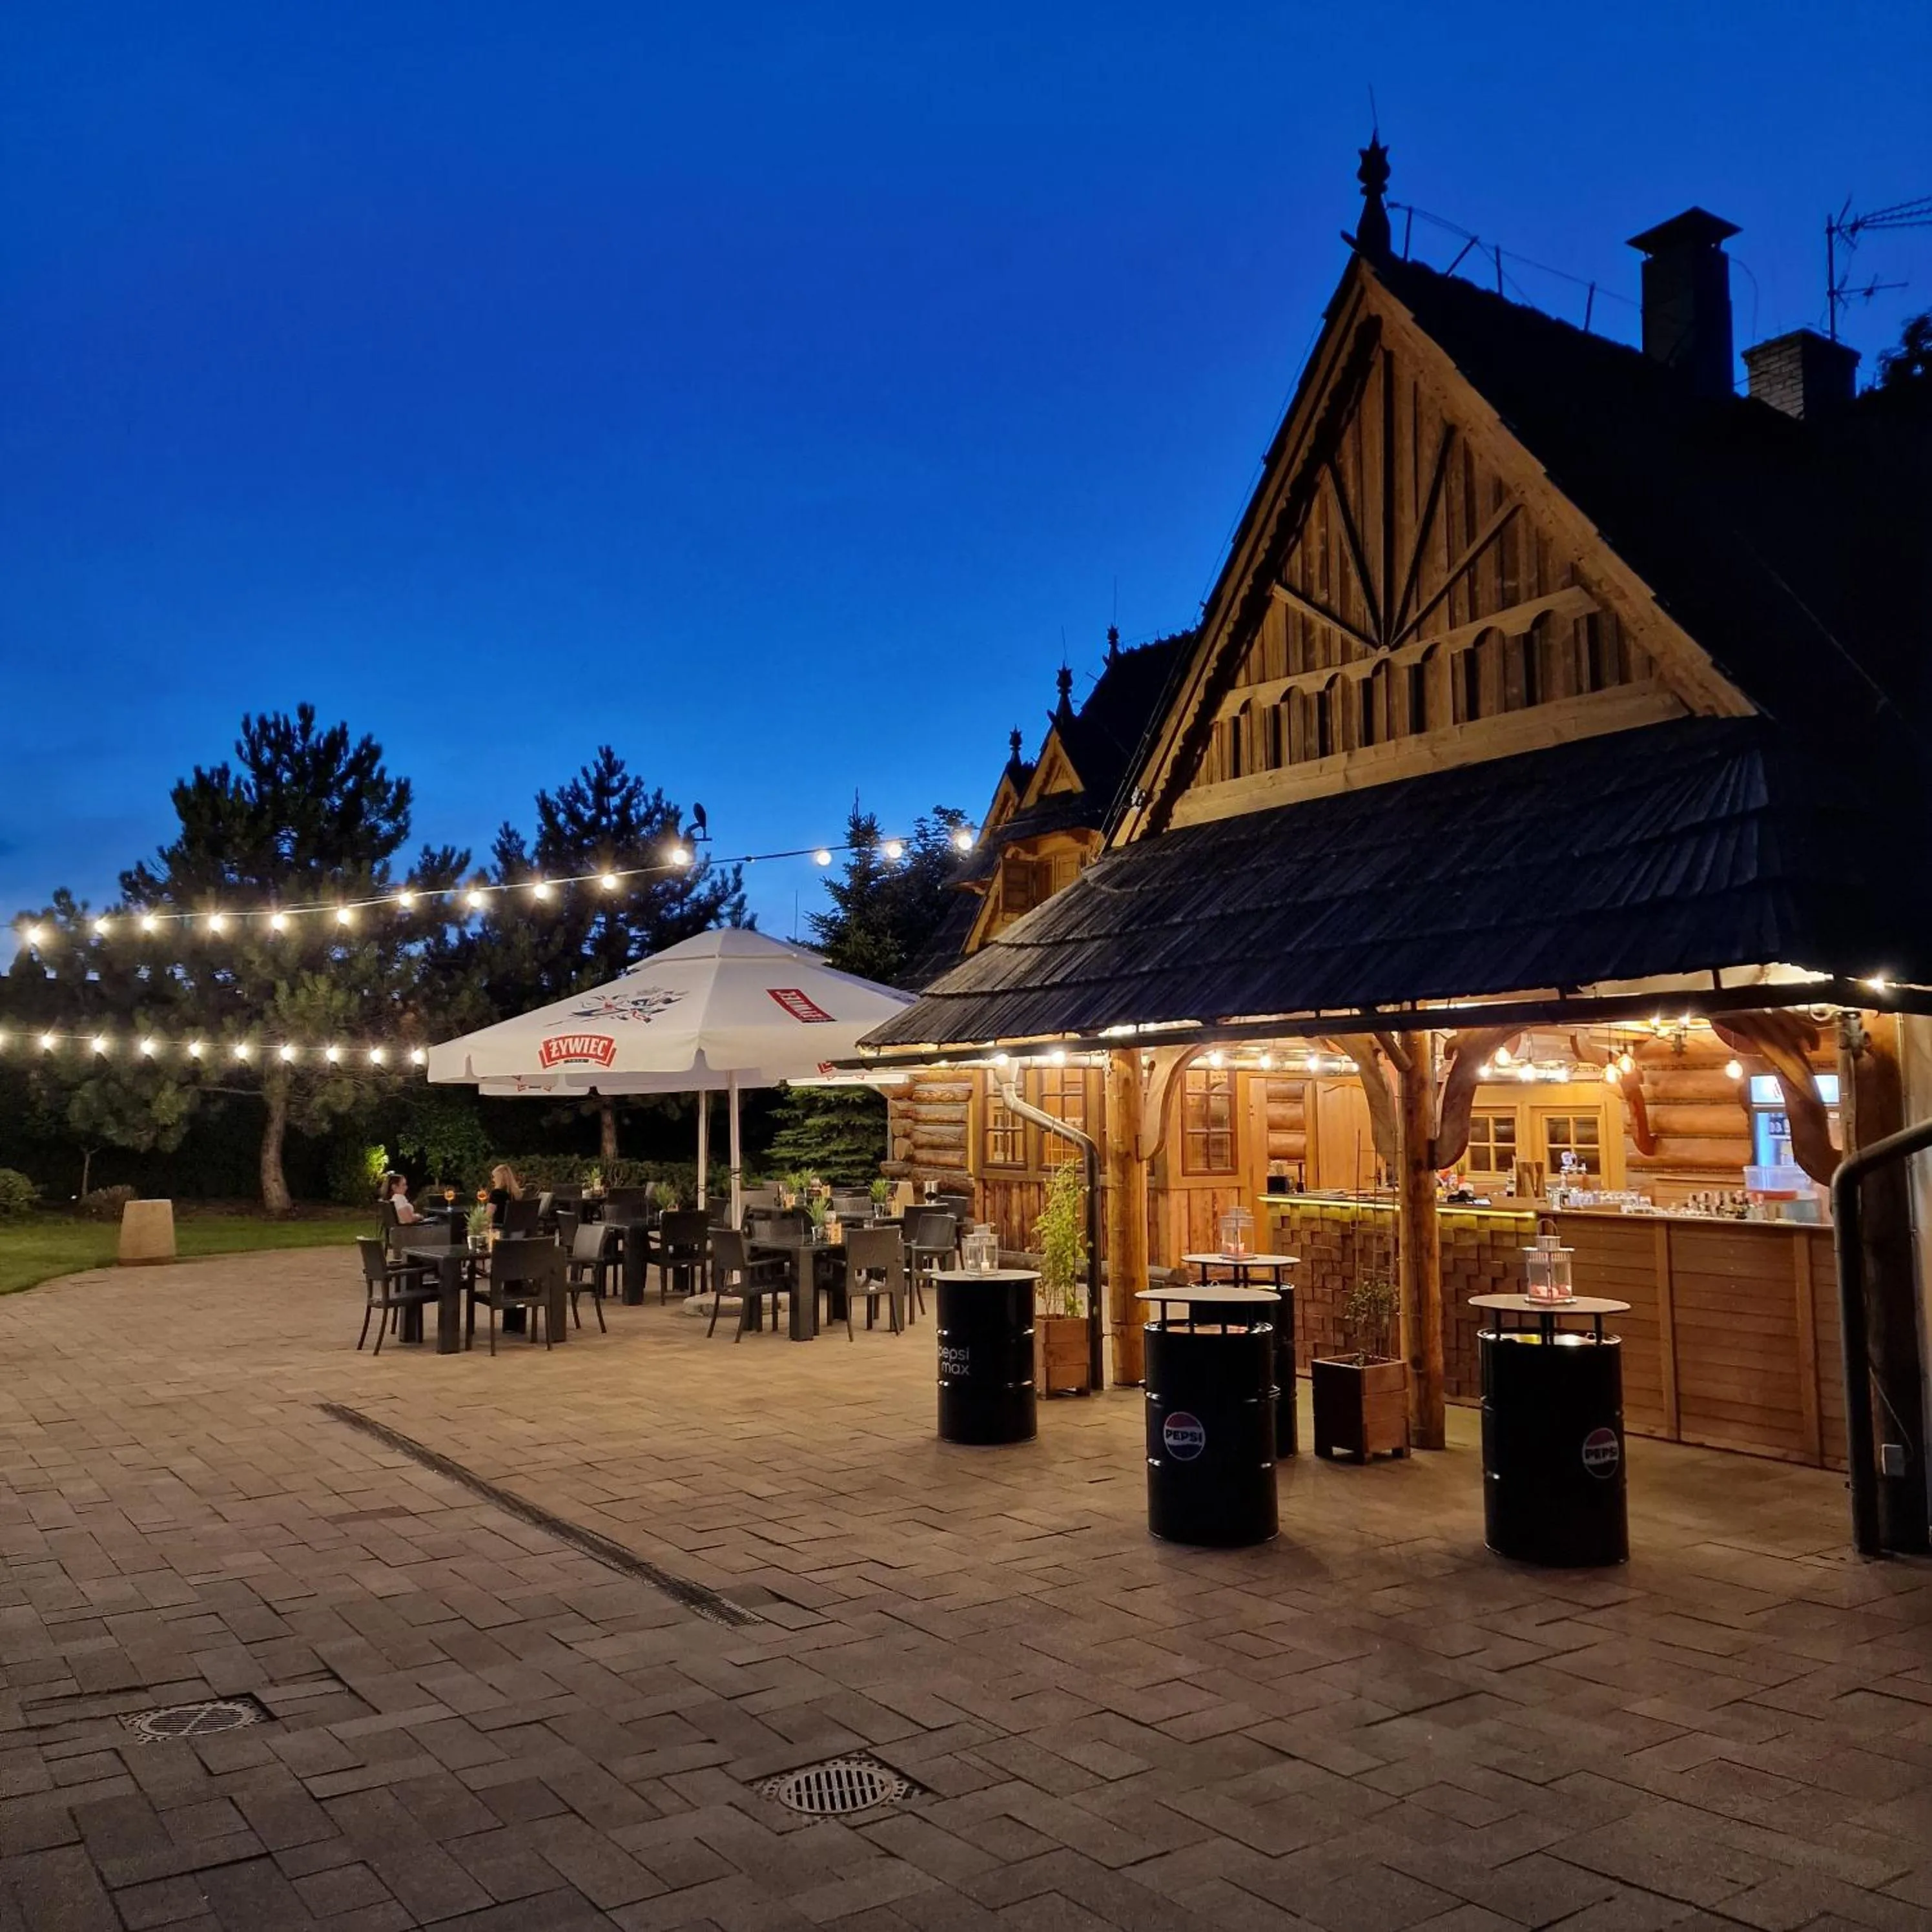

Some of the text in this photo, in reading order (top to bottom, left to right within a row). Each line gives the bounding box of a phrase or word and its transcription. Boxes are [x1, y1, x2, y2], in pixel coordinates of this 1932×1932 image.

[549, 1036, 608, 1058] ŻYWIEC
[941, 1362, 969, 1375] max
[1166, 1429, 1202, 1443] PEPSI
[1585, 1446, 1618, 1459] PEPS
